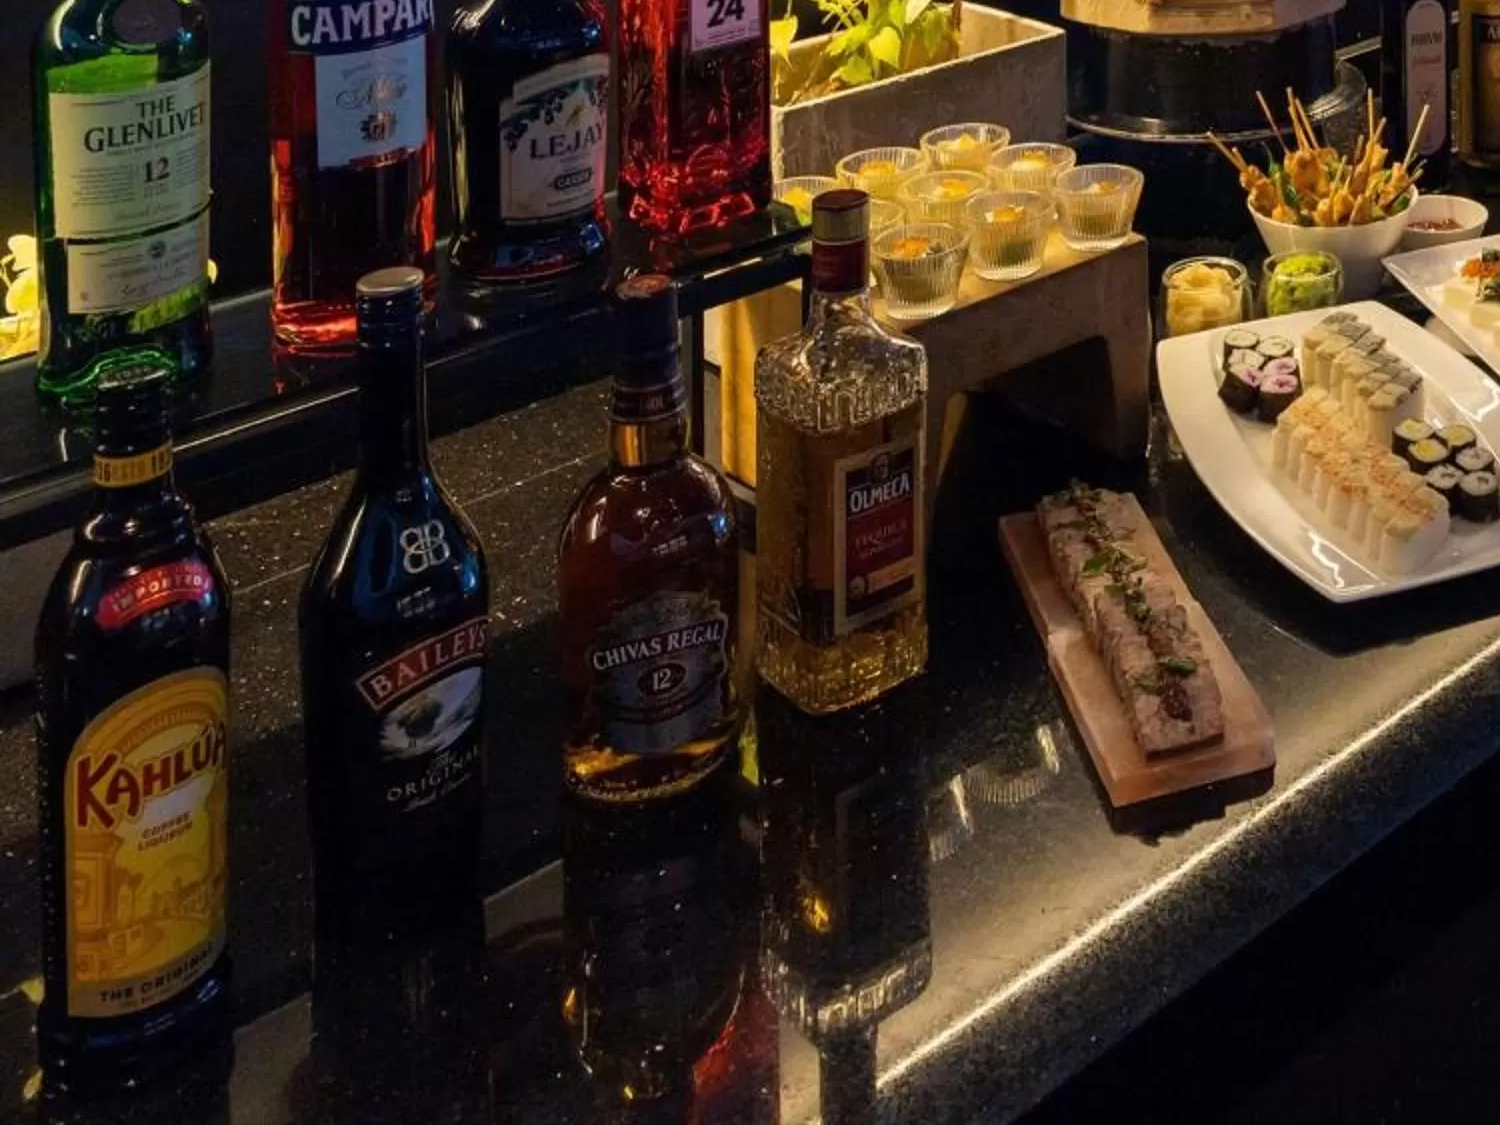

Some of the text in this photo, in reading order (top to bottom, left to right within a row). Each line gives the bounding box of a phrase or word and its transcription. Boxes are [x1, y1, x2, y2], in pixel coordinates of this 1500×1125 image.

[83, 101, 205, 153] GLENLIVET
[135, 95, 176, 119] THE
[144, 156, 171, 184] 12
[849, 472, 911, 513] OLMECA
[371, 625, 486, 704] BAILEYS
[592, 622, 721, 671] CHIVAS REGAL
[652, 667, 672, 691] 12
